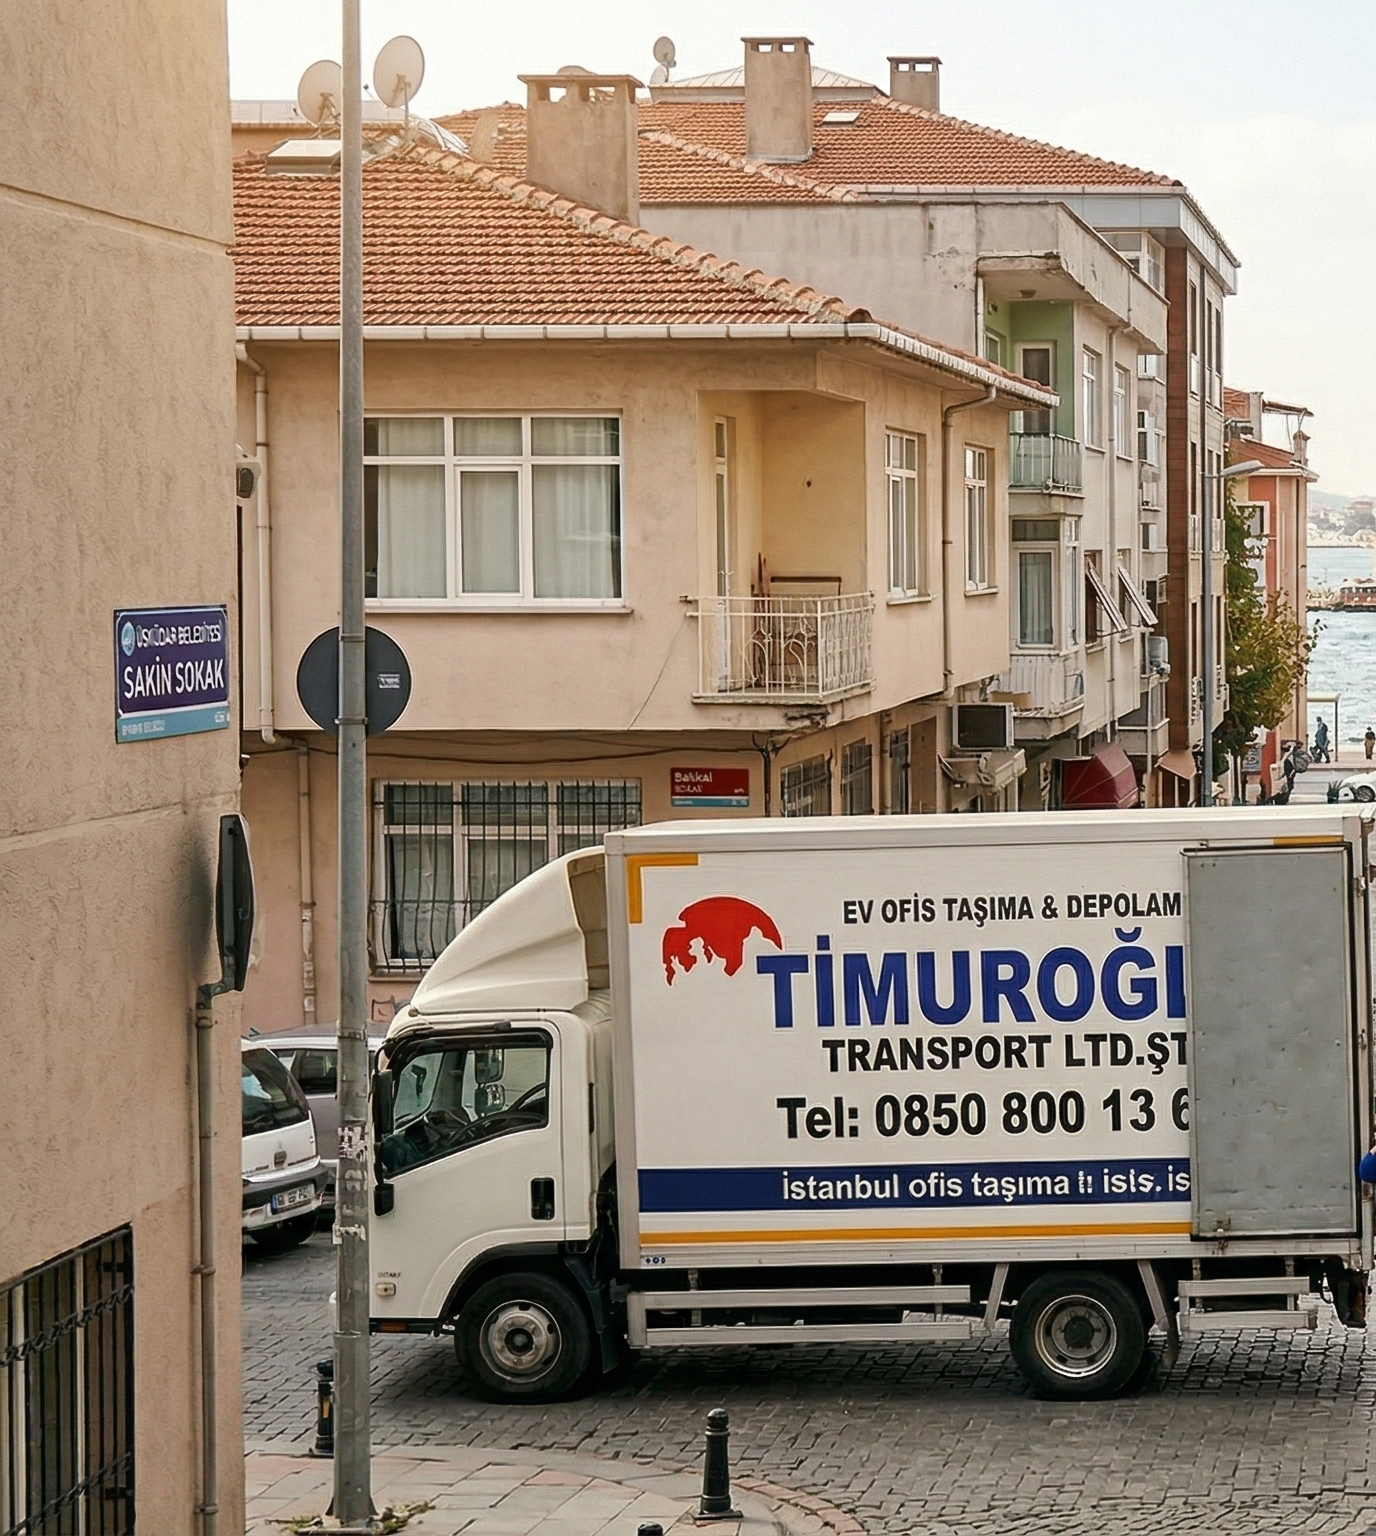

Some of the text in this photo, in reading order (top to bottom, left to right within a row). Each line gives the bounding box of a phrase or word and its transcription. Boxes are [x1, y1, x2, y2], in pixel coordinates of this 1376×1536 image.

[124, 656, 224, 699] SAKİN SOKAK
[843, 900, 874, 924] EV
[881, 892, 935, 923] OFİS
[942, 896, 1034, 928] TAŞIMA
[1041, 895, 1059, 919] &
[822, 1034, 1052, 1073] TRANSPORT
[776, 1096, 859, 1139] Tel:
[875, 1093, 986, 1137] 0850
[1001, 1090, 1086, 1135] 800
[1102, 1088, 1156, 1132] 13
[908, 1172, 963, 1199] ofis
[971, 1171, 1070, 1203] taşıma
